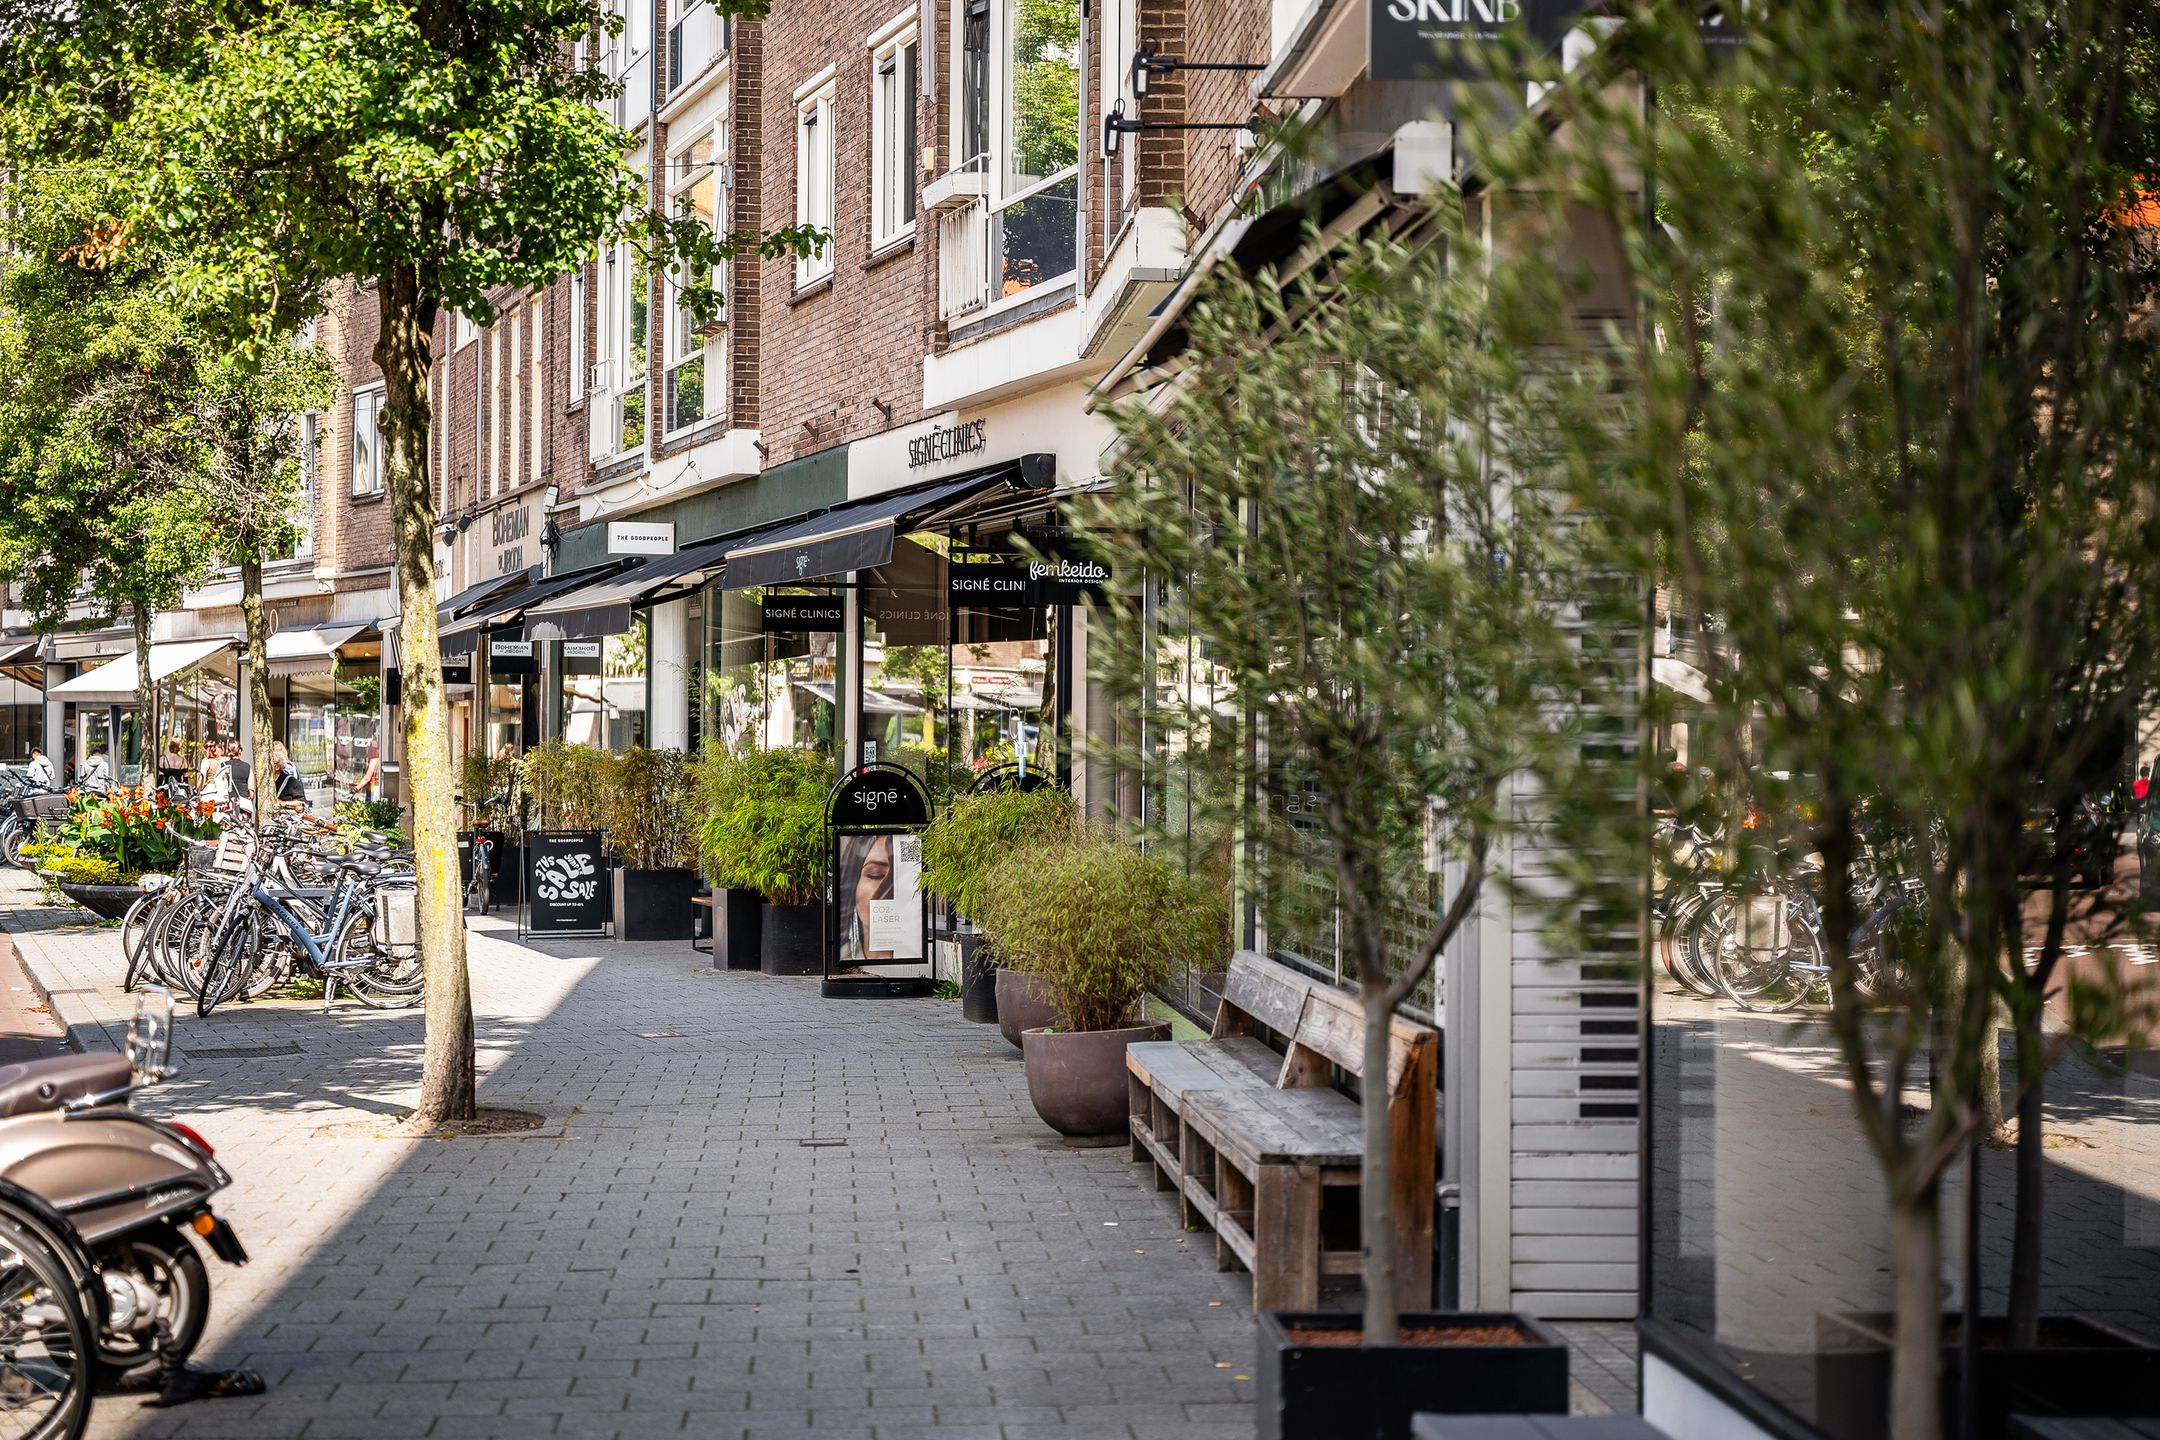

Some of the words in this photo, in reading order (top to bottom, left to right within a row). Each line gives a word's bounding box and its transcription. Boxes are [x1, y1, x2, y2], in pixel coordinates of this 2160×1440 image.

[492, 505, 529, 547] BOHEMIAN
[952, 578, 990, 591] SIGNÉ
[993, 581, 1026, 591] CLINI
[765, 608, 797, 619] SIGNÉ
[799, 609, 841, 619] CLINICS
[560, 881, 598, 900] SALE
[872, 915, 900, 923] LASER
